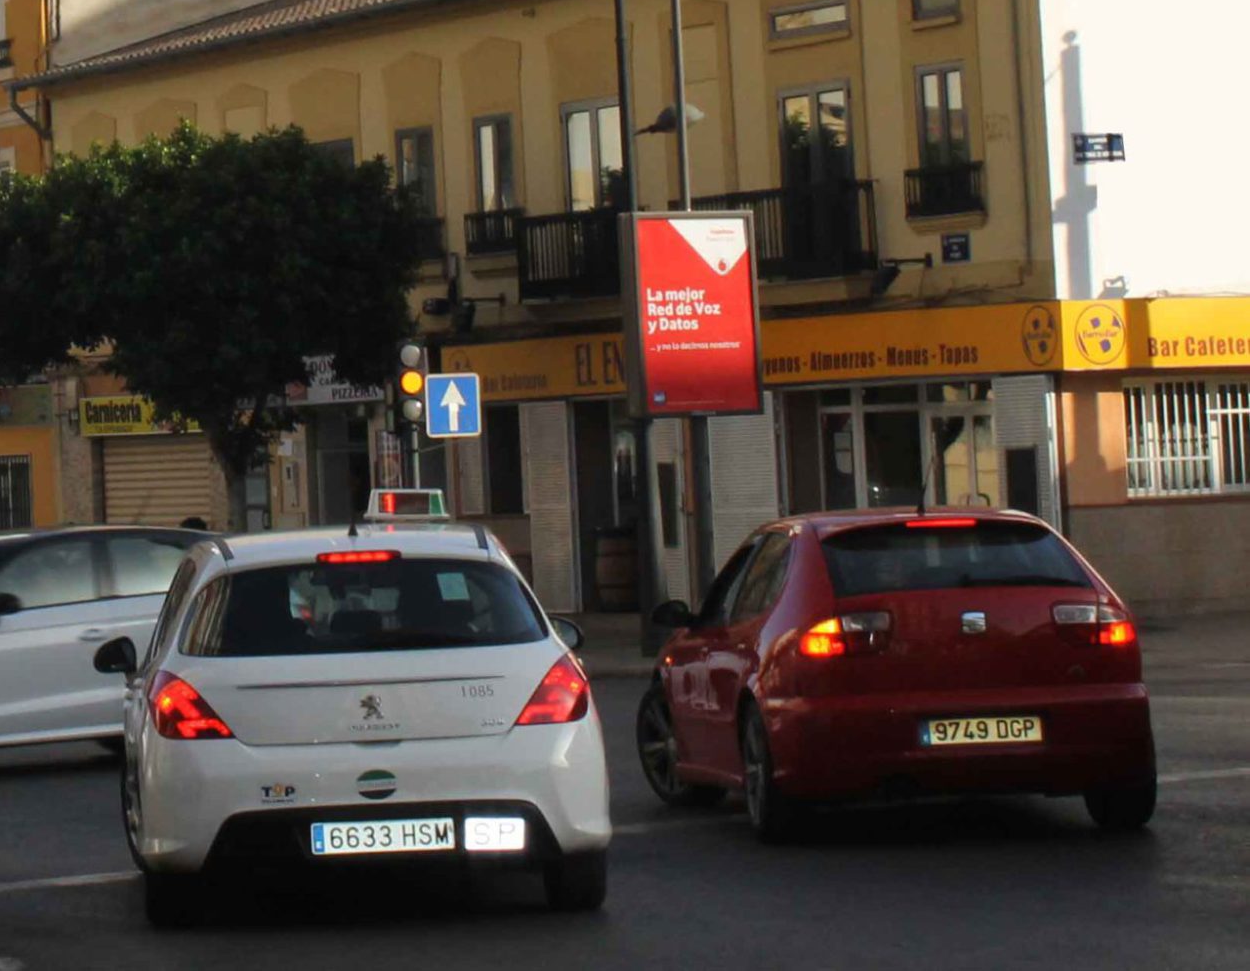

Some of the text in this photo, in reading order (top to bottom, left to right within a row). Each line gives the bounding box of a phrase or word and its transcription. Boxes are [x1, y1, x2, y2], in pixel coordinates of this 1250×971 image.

[647, 287, 705, 302] La mejor
[648, 302, 720, 316] Red de Voz
[648, 317, 699, 334] y Datos
[1147, 337, 1179, 357] Bar
[575, 341, 625, 386] EL EN
[763, 356, 800, 375] yunos
[810, 351, 875, 371] Almuerzos
[939, 344, 978, 365] Tapas
[461, 685, 495, 699] 1085
[935, 718, 1035, 741] 9749 DGP
[329, 822, 449, 849] 6633 HSM
